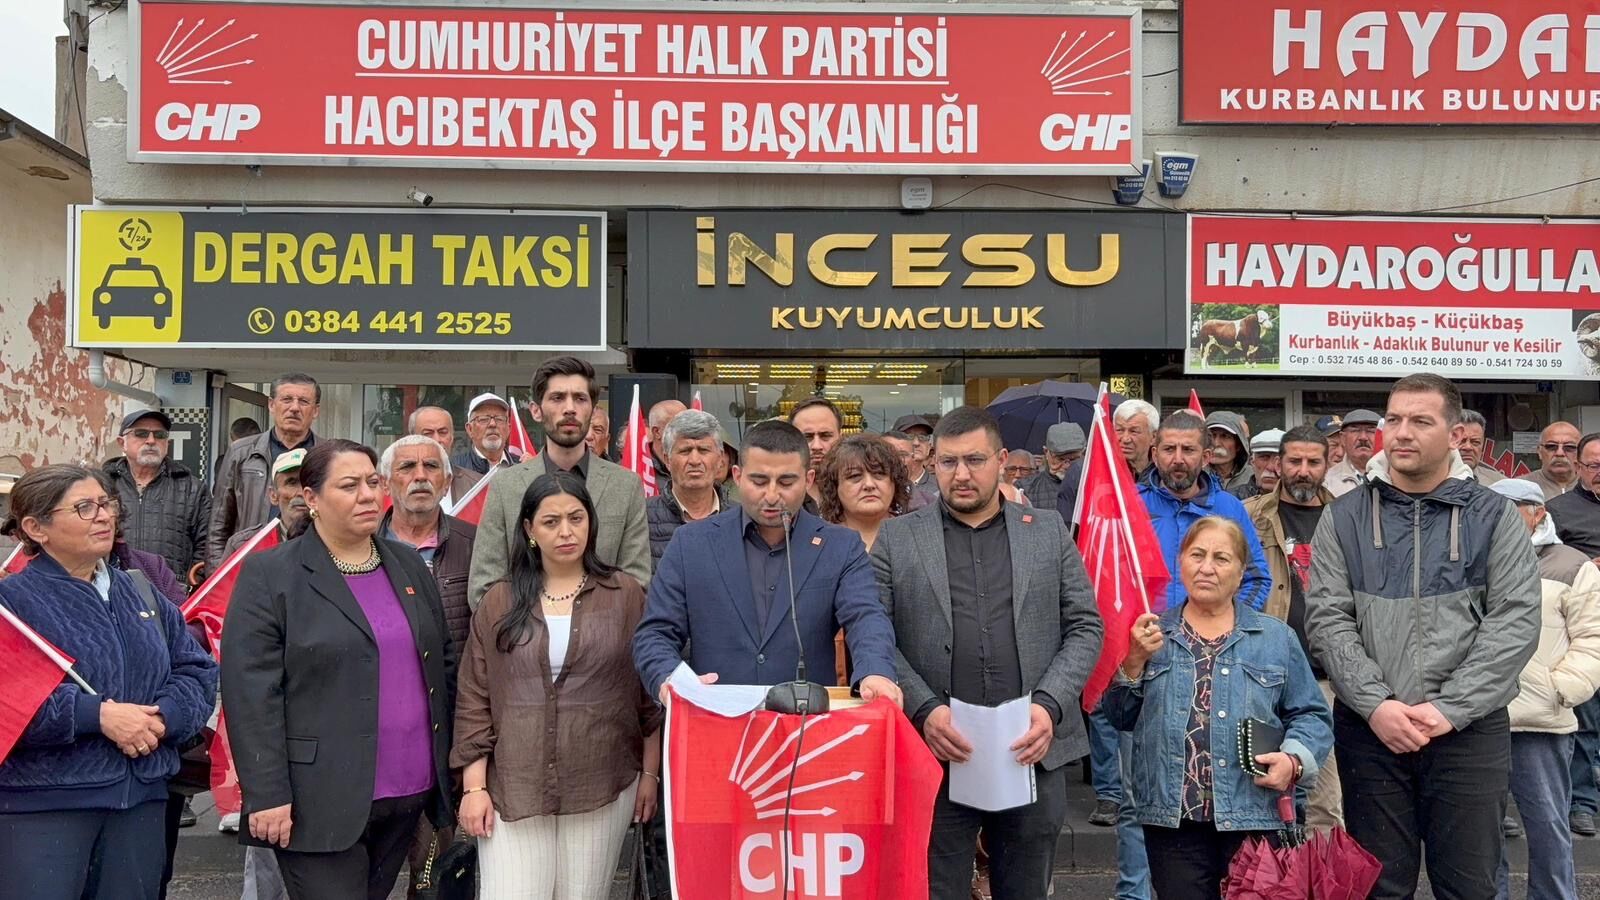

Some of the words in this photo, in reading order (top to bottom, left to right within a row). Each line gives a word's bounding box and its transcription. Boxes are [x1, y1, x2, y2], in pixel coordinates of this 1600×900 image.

[357, 12, 642, 72] CUMHURİYET
[656, 25, 768, 76] HALK
[783, 17, 947, 77] PARTİSİ
[1220, 88, 1425, 111] KURBANLIK
[154, 102, 261, 141] CHP
[325, 95, 597, 156] HACIBEKTAŞ
[613, 89, 706, 158] İLÇE
[721, 93, 977, 159] BAŞKANLIĞI
[1040, 113, 1131, 151] CHP
[193, 231, 414, 285] DERGAH
[433, 224, 590, 288] TAKSİ
[696, 216, 1120, 287] İNCESU
[285, 309, 360, 333] 0384
[370, 311, 424, 334] 441
[437, 312, 512, 335] 2525
[771, 305, 1045, 330] KUYUMCULUK
[1328, 311, 1416, 331] Büyükbaş
[1435, 313, 1524, 333] Küçükbaş
[1289, 334, 1359, 350] Kurbanlık
[1373, 336, 1427, 351] Adaklık
[1432, 337, 1489, 352] Bulunur
[1493, 340, 1510, 352] ve
[1514, 338, 1562, 353] Kesilir
[1289, 354, 1309, 365] Cep
[1318, 355, 1344, 365] 0.532
[1347, 355, 1364, 365] 745
[1366, 356, 1379, 365] 48
[1381, 356, 1393, 365] 86
[1402, 357, 1428, 366] 0.542
[1431, 357, 1448, 366] 640
[1451, 357, 1463, 367] 89
[1465, 357, 1477, 367] 50
[1486, 358, 1512, 367] 0.541
[1515, 358, 1533, 368] 724
[1536, 359, 1548, 368] 30
[1550, 359, 1563, 368] 59
[739, 830, 865, 897] CHP
